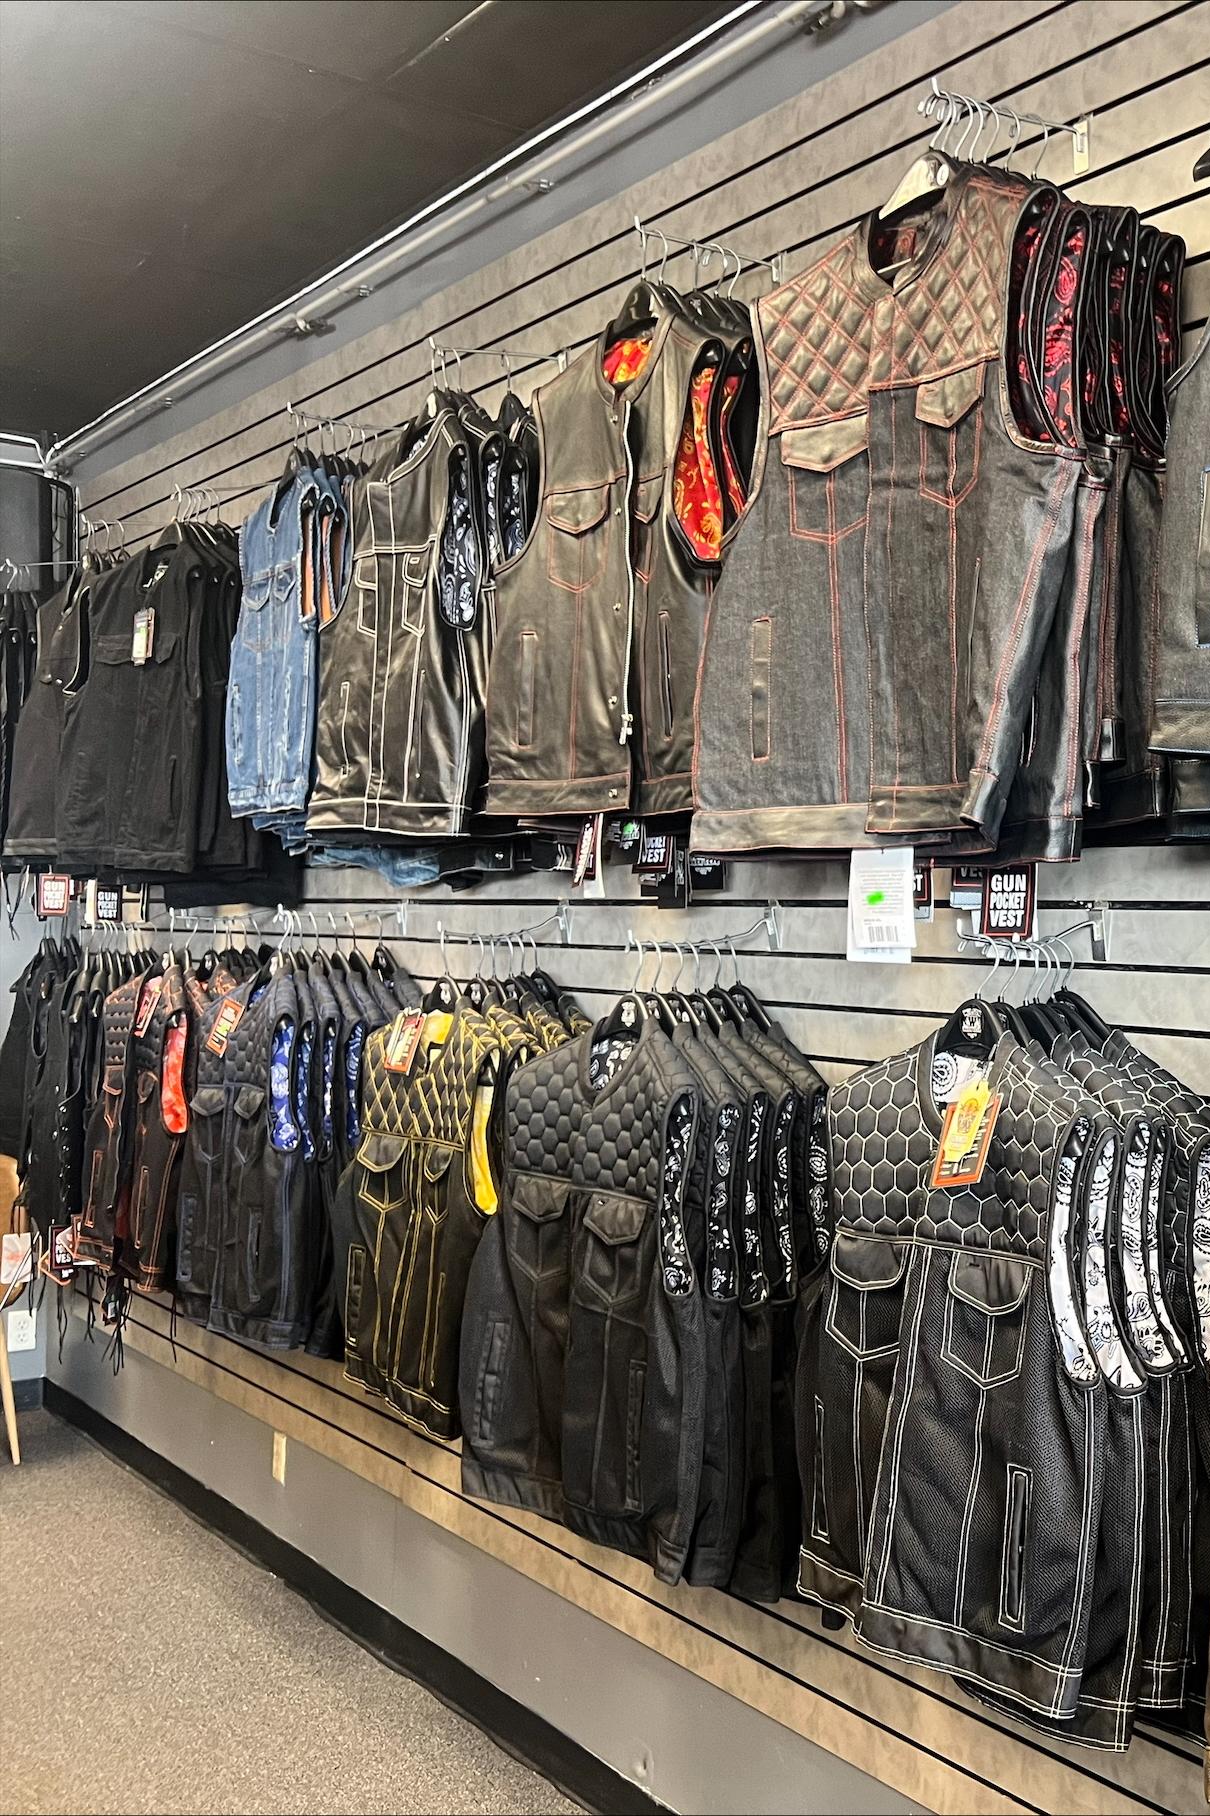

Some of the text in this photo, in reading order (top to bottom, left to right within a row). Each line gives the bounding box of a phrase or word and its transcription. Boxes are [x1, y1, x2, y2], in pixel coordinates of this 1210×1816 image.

[991, 874, 1026, 892] GUN
[97, 891, 118, 901] GUN
[990, 892, 1026, 910] POCKET
[97, 909, 117, 918] VEST
[989, 910, 1025, 927] VEST
